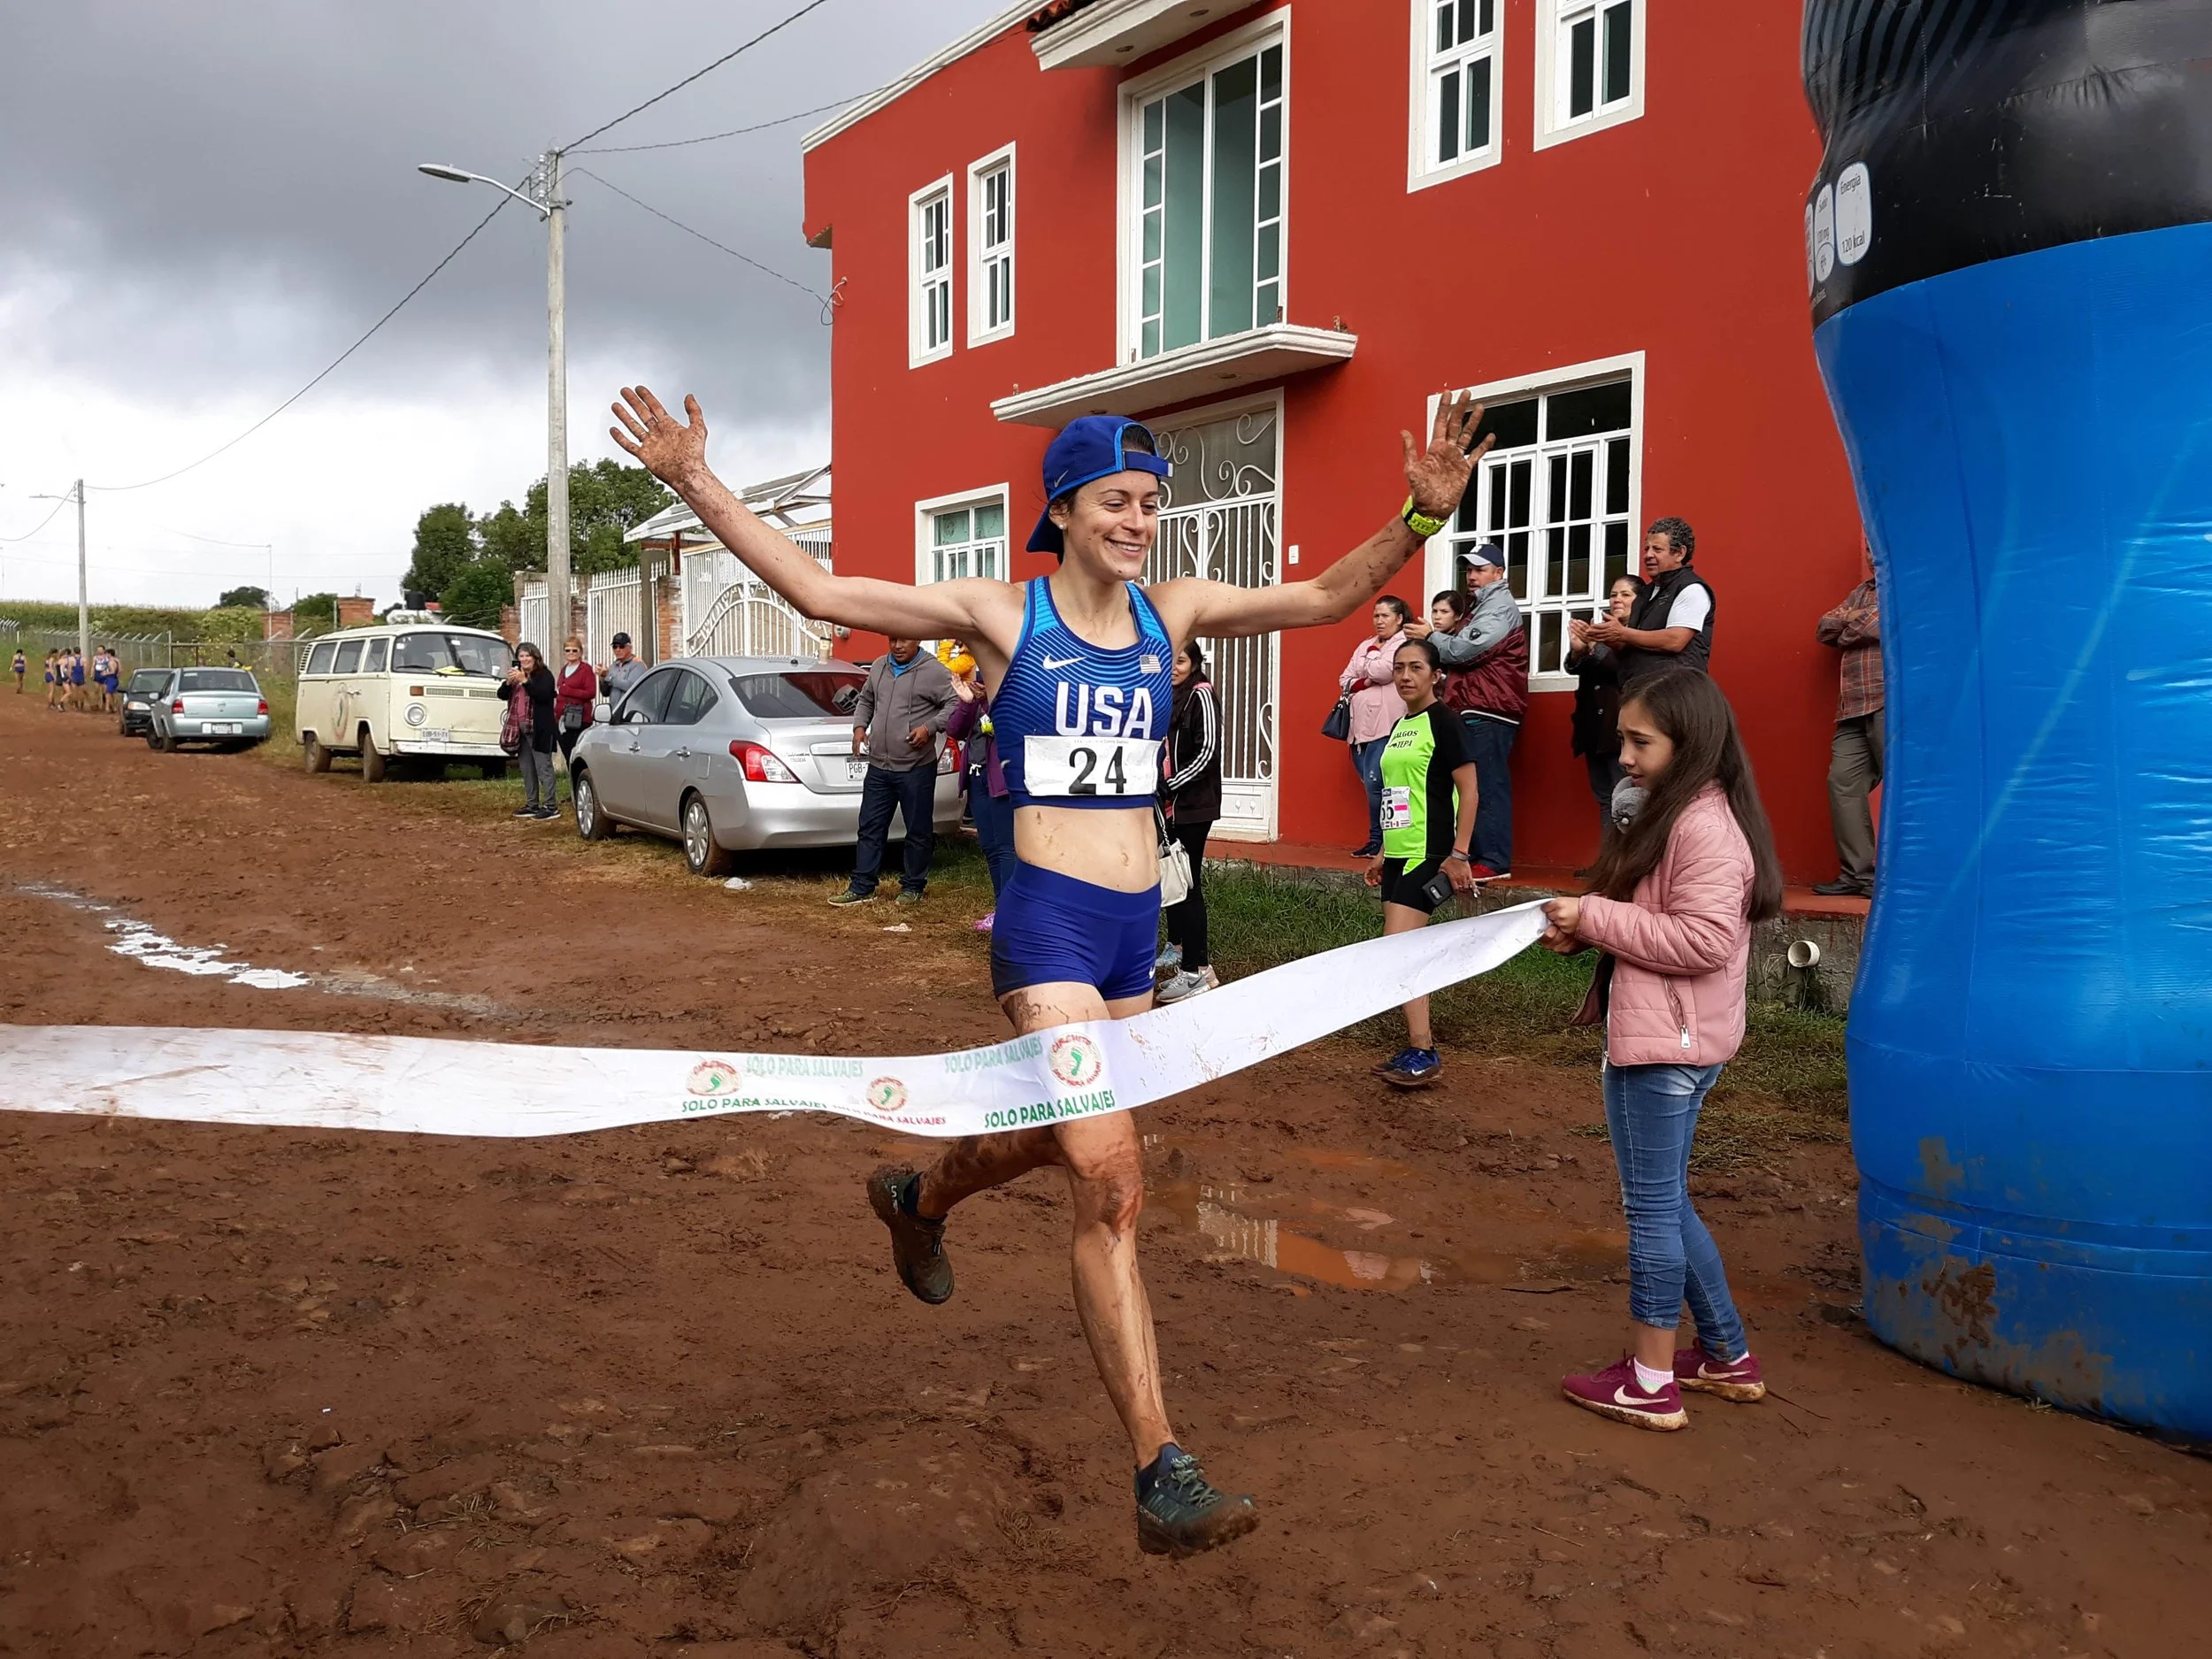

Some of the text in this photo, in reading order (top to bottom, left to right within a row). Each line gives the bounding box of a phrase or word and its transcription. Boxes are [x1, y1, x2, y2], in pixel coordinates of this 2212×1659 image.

[1841, 230, 1866, 254] 120 kcal
[1055, 681, 1153, 740] USA
[849, 763, 869, 773] PGB-
[1068, 746, 1127, 795] 24
[746, 1056, 776, 1077] SOLO
[778, 1057, 810, 1077] PARA
[812, 1059, 864, 1079] SALVAJES
[944, 1035, 1043, 1073] SOLO PARA SALVAJES
[681, 1099, 718, 1113] SOLO
[722, 1098, 761, 1109] PARA
[985, 1089, 1116, 1128] SOLO PARA SALVAJES
